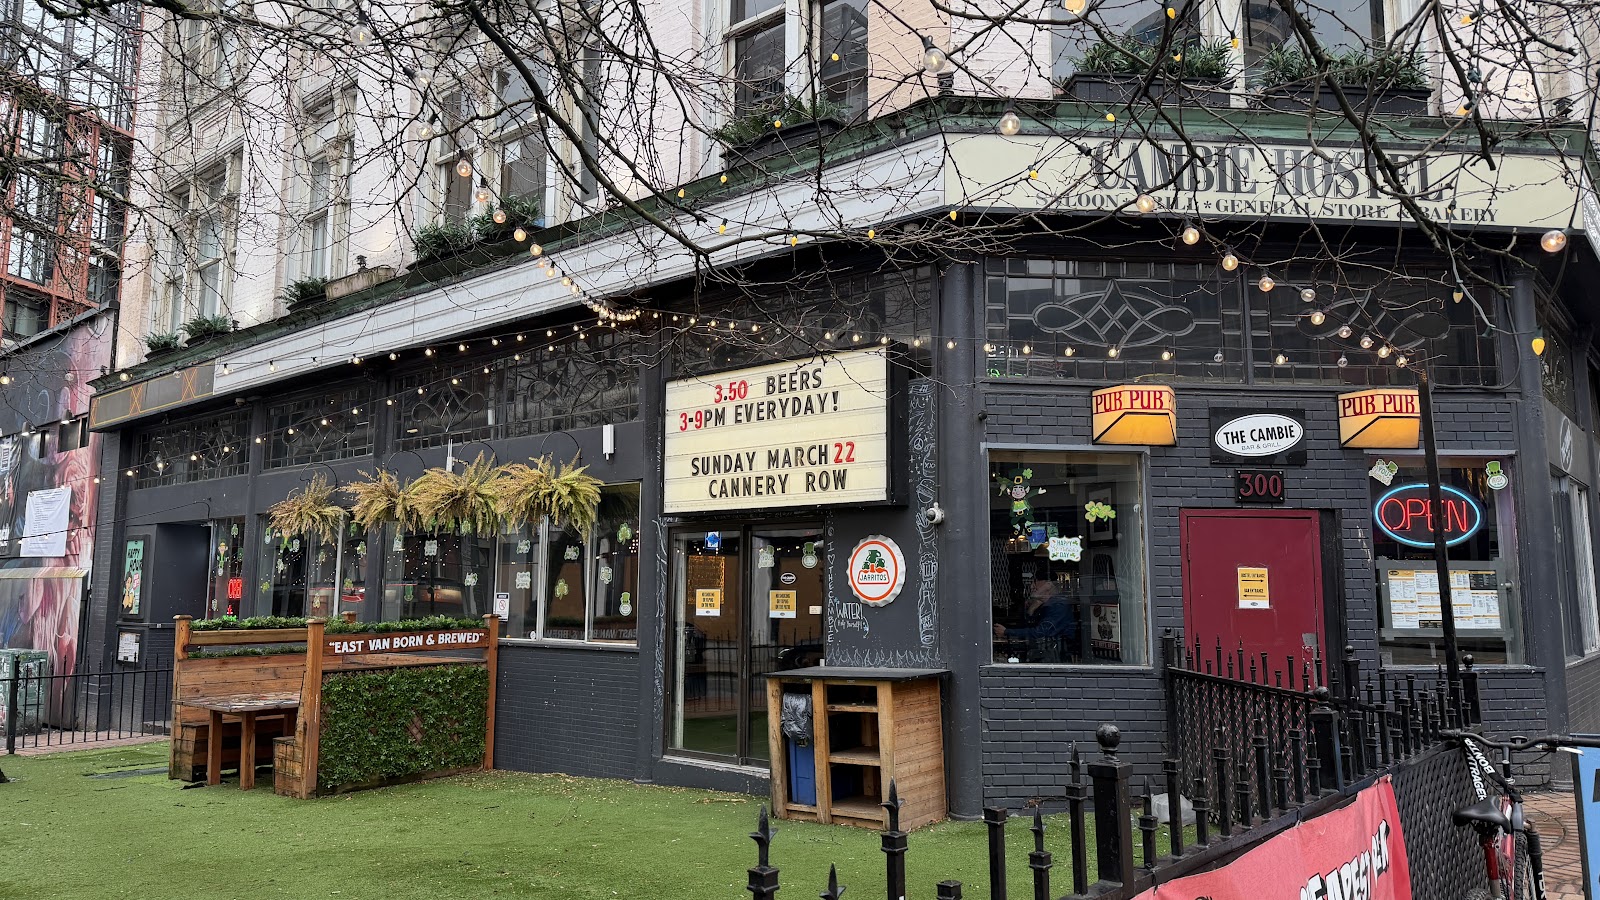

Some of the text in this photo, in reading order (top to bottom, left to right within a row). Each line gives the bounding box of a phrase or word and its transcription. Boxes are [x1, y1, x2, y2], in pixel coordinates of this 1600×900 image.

[1091, 140, 1257, 194] CAMBIE
[1035, 193, 1119, 208] SLOON
[1138, 195, 1200, 211] RILL
[1215, 198, 1316, 216] GENERAL
[1322, 202, 1389, 219] STORE
[1420, 206, 1499, 222] BAKERY
[713, 367, 823, 404] 3.50 BEERS
[679, 390, 840, 432] 3-9PM EVERYDAY!
[1095, 390, 1123, 414] PUB
[1129, 390, 1164, 410] PUB
[1342, 394, 1416, 417] PUB PUB
[1223, 424, 1296, 445] THE CAMBIE
[691, 441, 856, 477] SUNDAY MARCH 22
[708, 468, 848, 499] CANNERY ROW
[1239, 473, 1282, 497] 300
[1381, 498, 1468, 532] OPEN
[835, 602, 863, 620] WATER!
[368, 638, 390, 651] VAN
[393, 635, 423, 648] BORN
[425, 634, 435, 645] &
